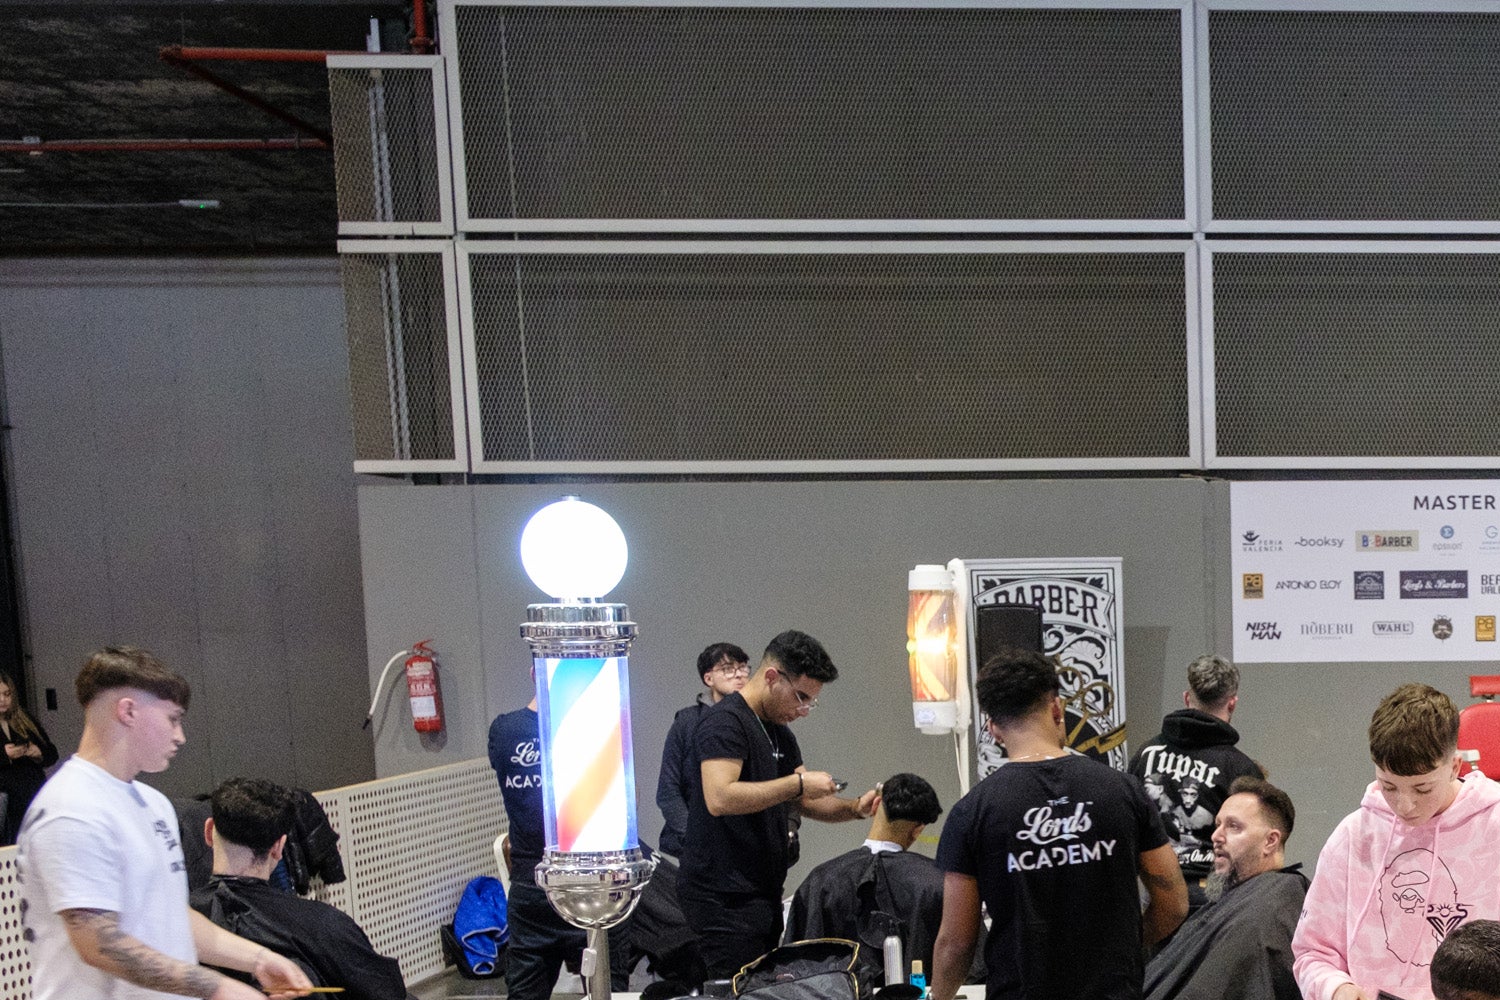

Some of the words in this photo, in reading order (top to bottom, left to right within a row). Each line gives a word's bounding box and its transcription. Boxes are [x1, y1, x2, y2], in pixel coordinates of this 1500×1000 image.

[1413, 495, 1496, 510] MASTER
[1295, 536, 1345, 548] booksy
[1275, 580, 1317, 590] ANTONIO
[1320, 580, 1342, 590] ELOY
[1246, 621, 1277, 632] NISH
[1377, 624, 1411, 633] WAHL
[1251, 631, 1281, 641] MAN
[505, 775, 542, 788] ACAD
[1047, 796, 1070, 806] THE
[1016, 802, 1093, 845] Lords
[1007, 840, 1117, 873] ACADEMY
